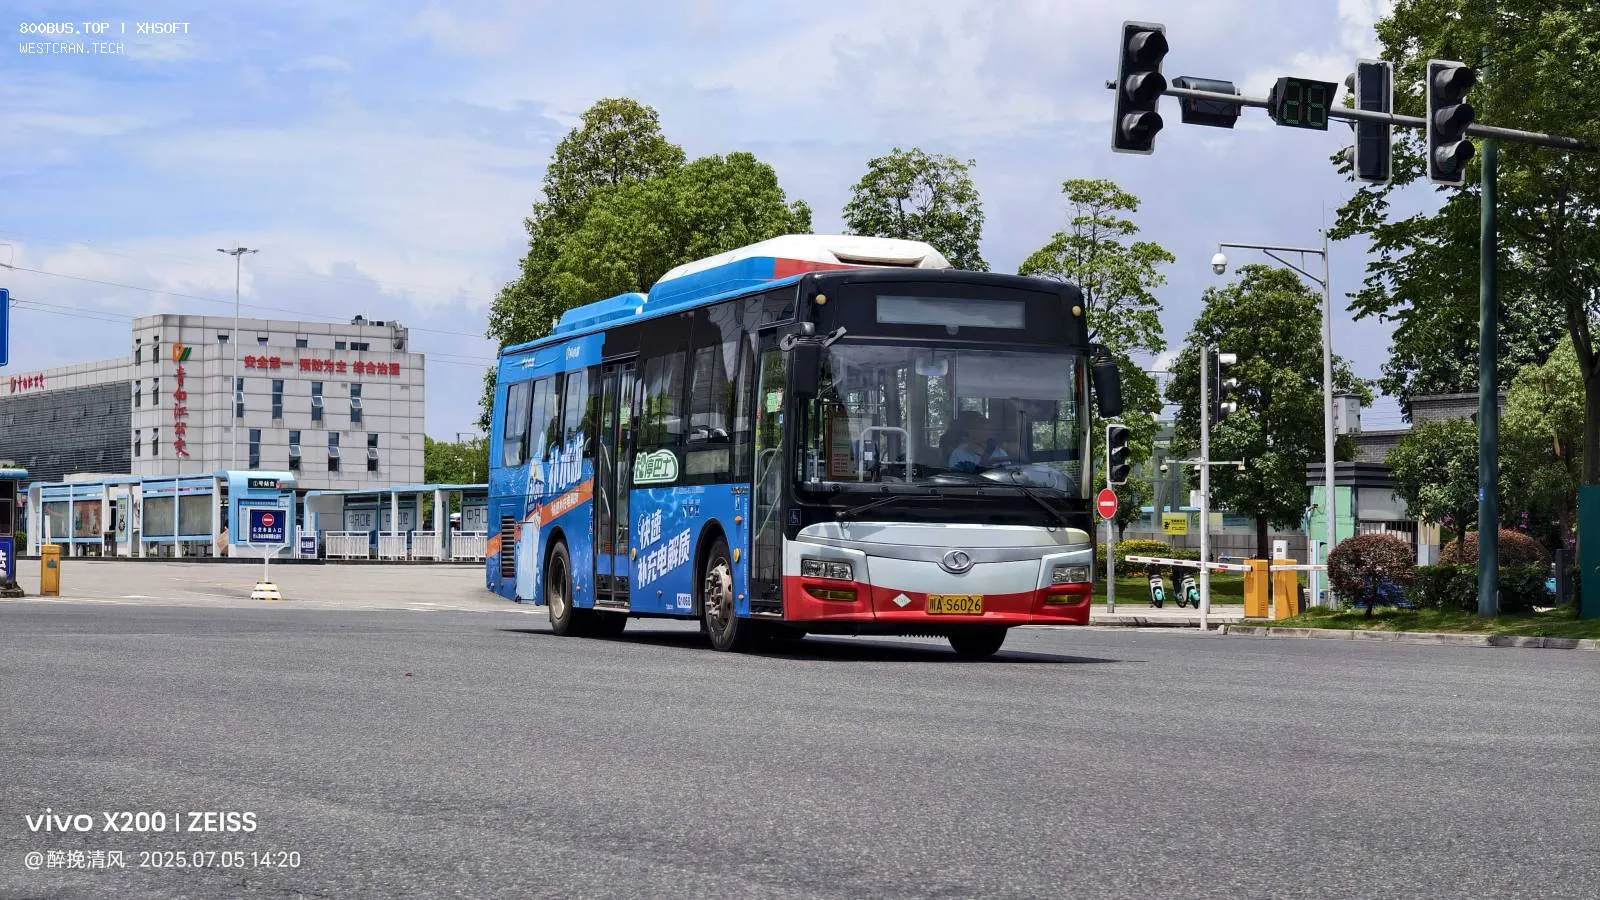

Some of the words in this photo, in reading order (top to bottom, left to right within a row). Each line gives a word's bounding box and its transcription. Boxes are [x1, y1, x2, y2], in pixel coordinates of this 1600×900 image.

[244, 355, 294, 369] 安全第一
[299, 358, 347, 373] 预防为主
[352, 360, 401, 376] 综合治理
[639, 508, 662, 550] 快速
[637, 527, 691, 590] 补充电解质
